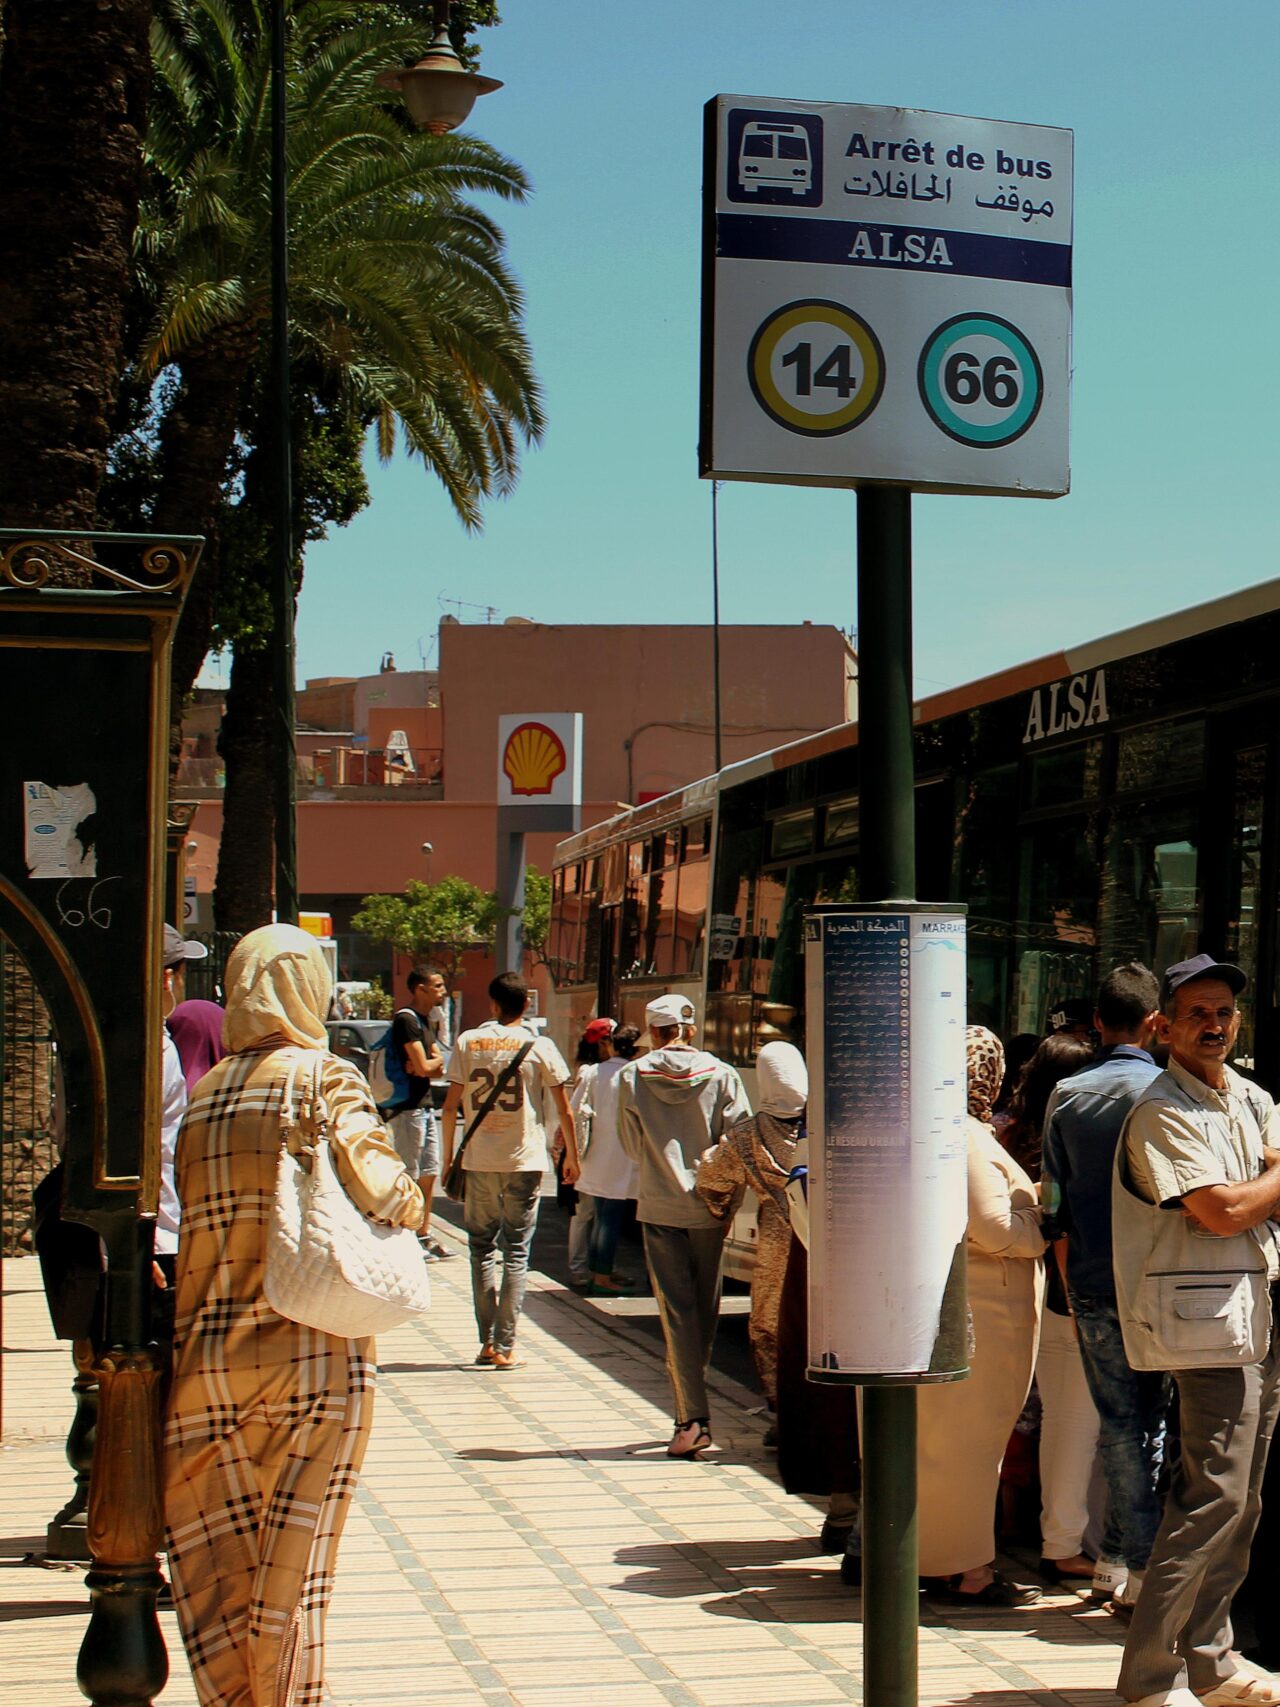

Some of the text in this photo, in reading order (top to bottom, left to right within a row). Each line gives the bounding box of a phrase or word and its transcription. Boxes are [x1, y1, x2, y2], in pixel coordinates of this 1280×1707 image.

[845, 133, 1053, 179] Arrêt de bus
[843, 170, 1054, 223] موقف الحافلات
[848, 230, 953, 266] ALSA
[781, 343, 856, 398] 14
[944, 352, 1019, 408] 66
[1021, 668, 1110, 744] ALSA
